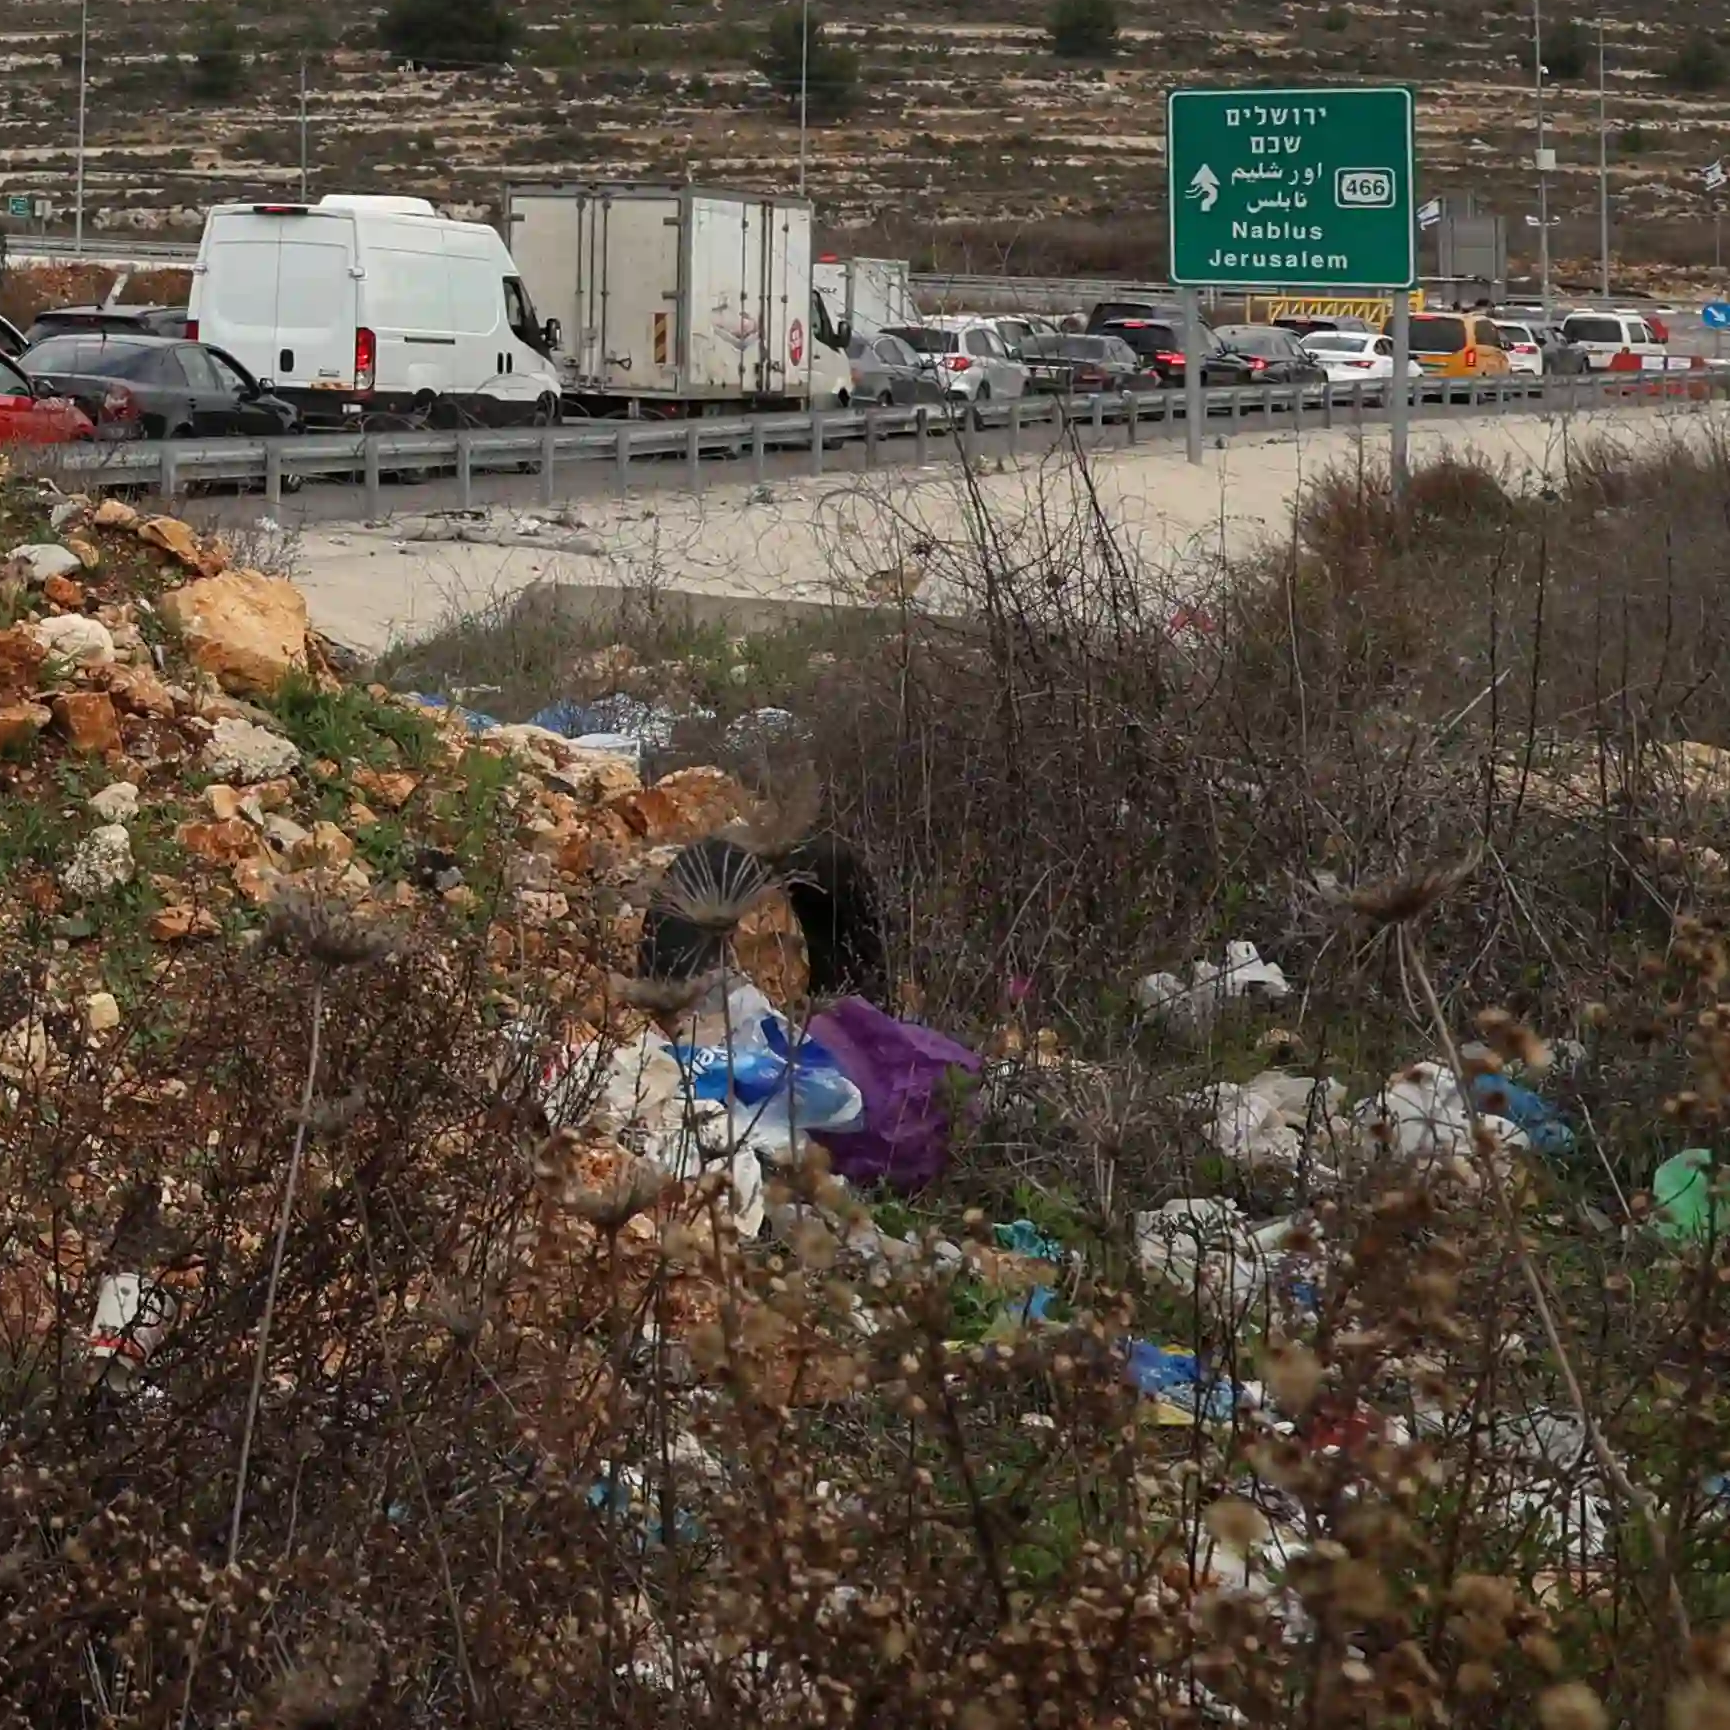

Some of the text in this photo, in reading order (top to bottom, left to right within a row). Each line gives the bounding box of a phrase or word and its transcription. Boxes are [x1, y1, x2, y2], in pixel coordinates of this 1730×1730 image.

[1226, 106, 1327, 126] ירושלים
[1250, 136, 1301, 154] שכם
[1346, 179, 1385, 197] 466
[1246, 191, 1307, 213] نابلس
[1232, 221, 1324, 240] Nablus
[1209, 250, 1348, 269] Jerusalem
